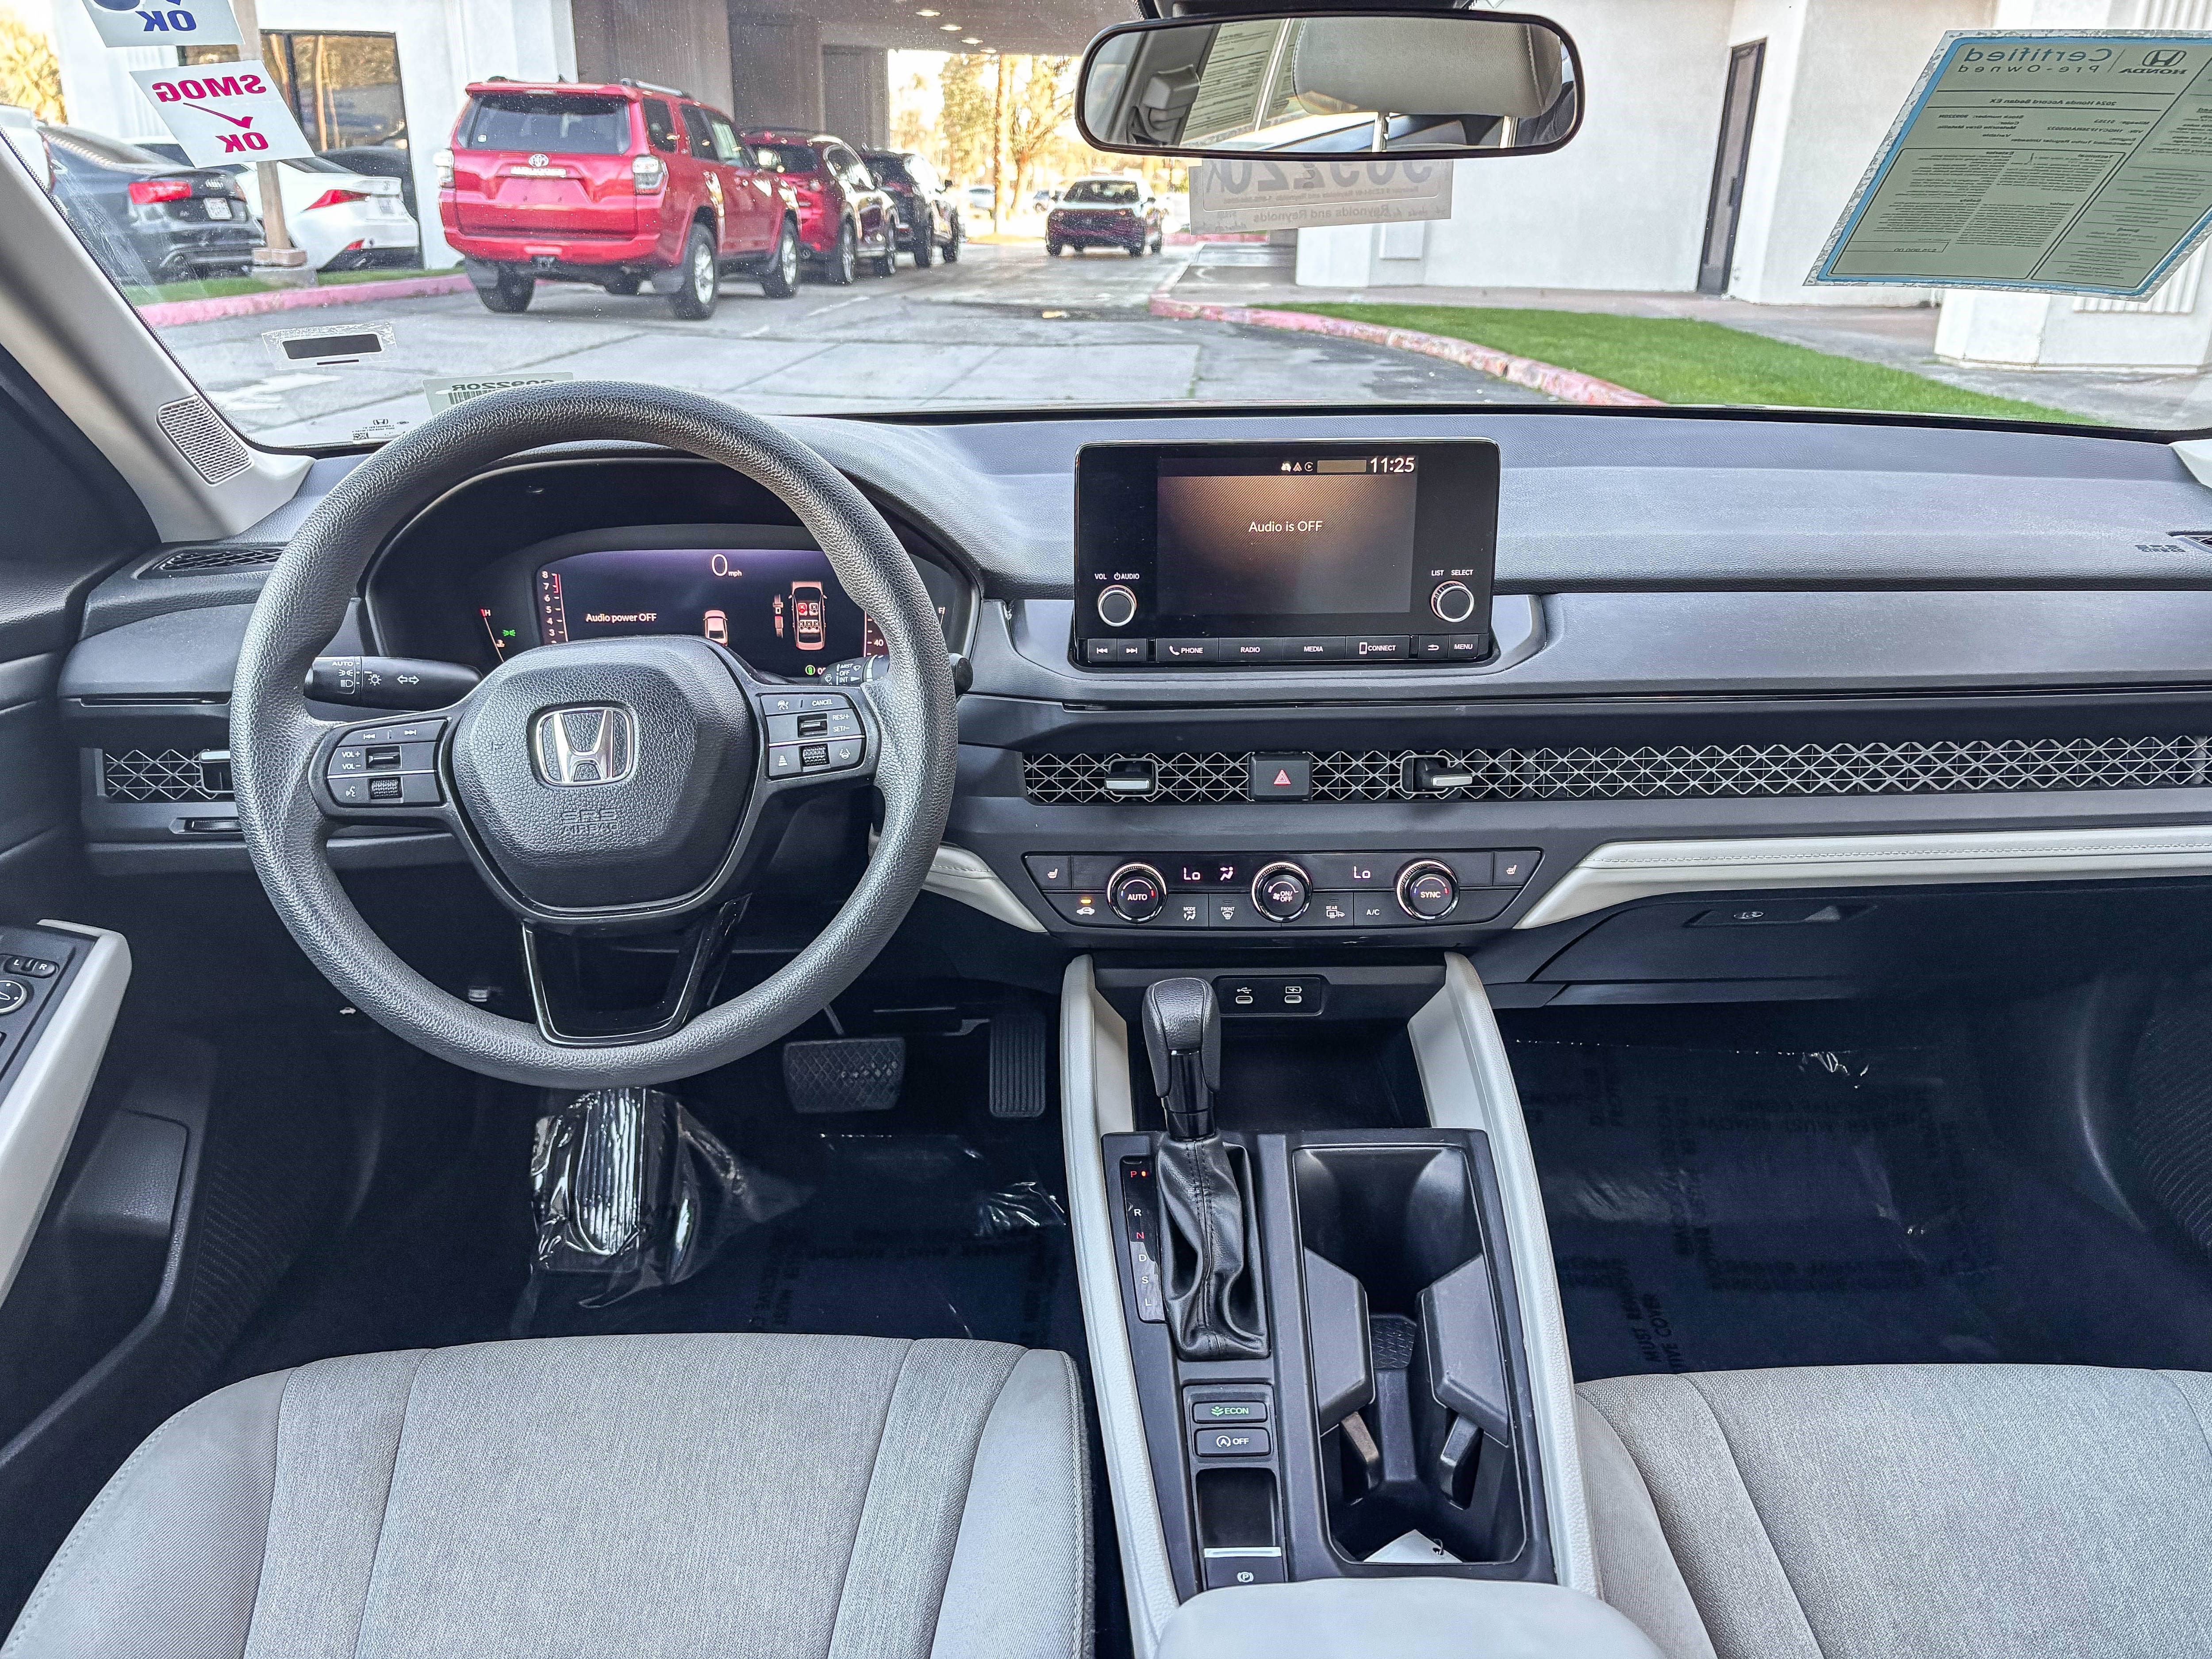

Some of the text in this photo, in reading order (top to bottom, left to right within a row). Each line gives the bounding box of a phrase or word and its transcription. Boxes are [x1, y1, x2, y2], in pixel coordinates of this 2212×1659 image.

[1370, 457, 1415, 473] 11:25
[1248, 521, 1323, 533] Audio is OFF
[711, 553, 728, 576] 0
[586, 613, 657, 624] Audio power OFF
[561, 808, 617, 822] SRS
[1183, 868, 1200, 880] Lo
[1354, 866, 1371, 879] Lo
